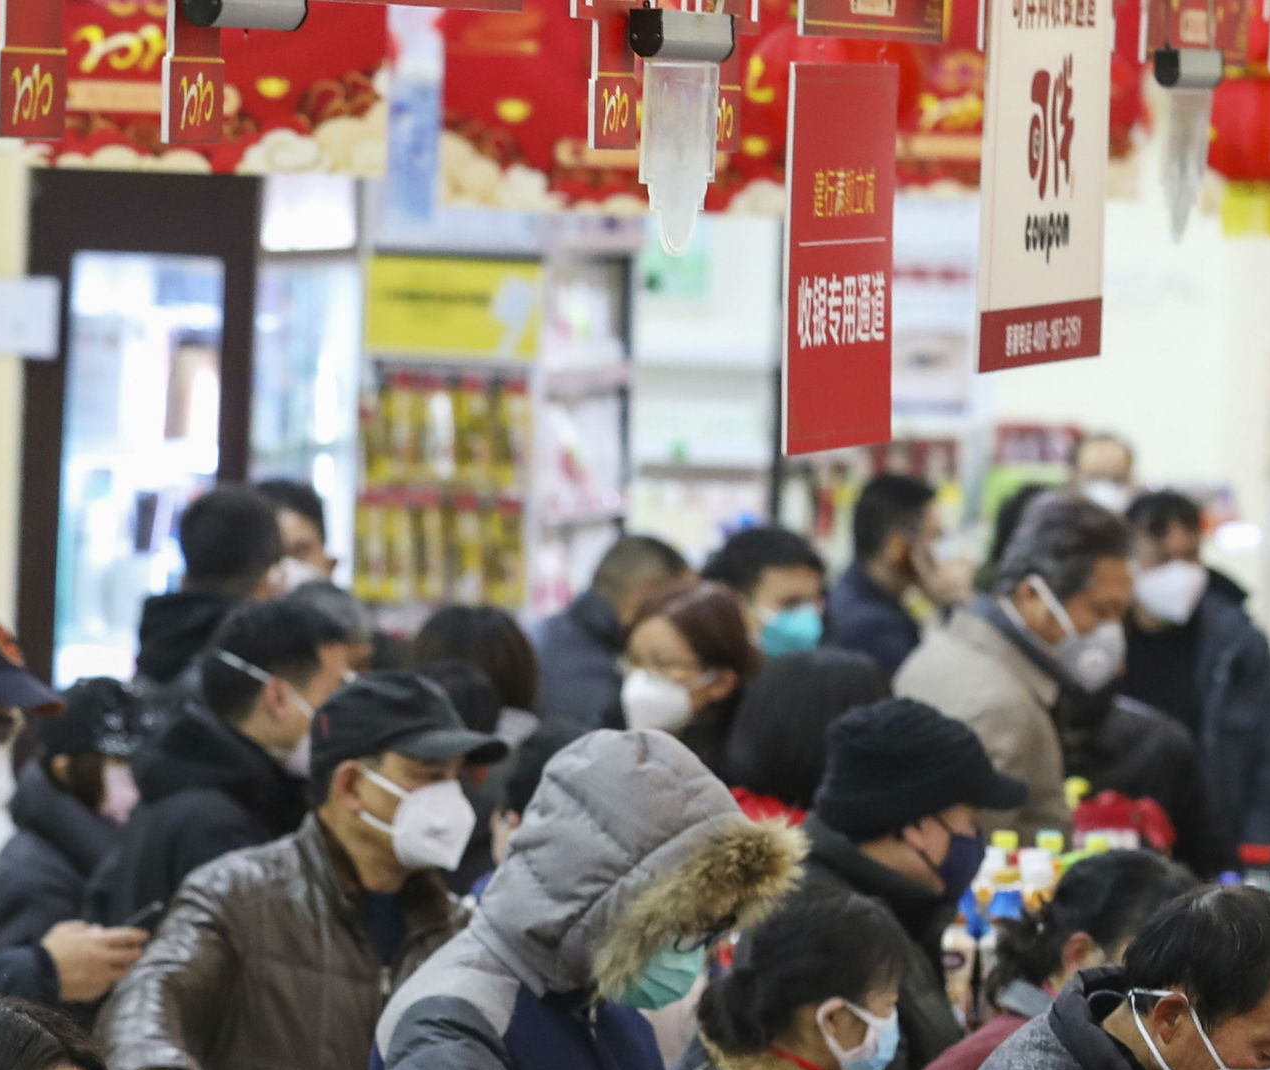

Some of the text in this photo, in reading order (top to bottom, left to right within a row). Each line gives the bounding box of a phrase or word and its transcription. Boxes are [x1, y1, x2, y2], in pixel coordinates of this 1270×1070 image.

[1025, 212, 1070, 264] coupon
[797, 270, 885, 350] 收银专用通道
